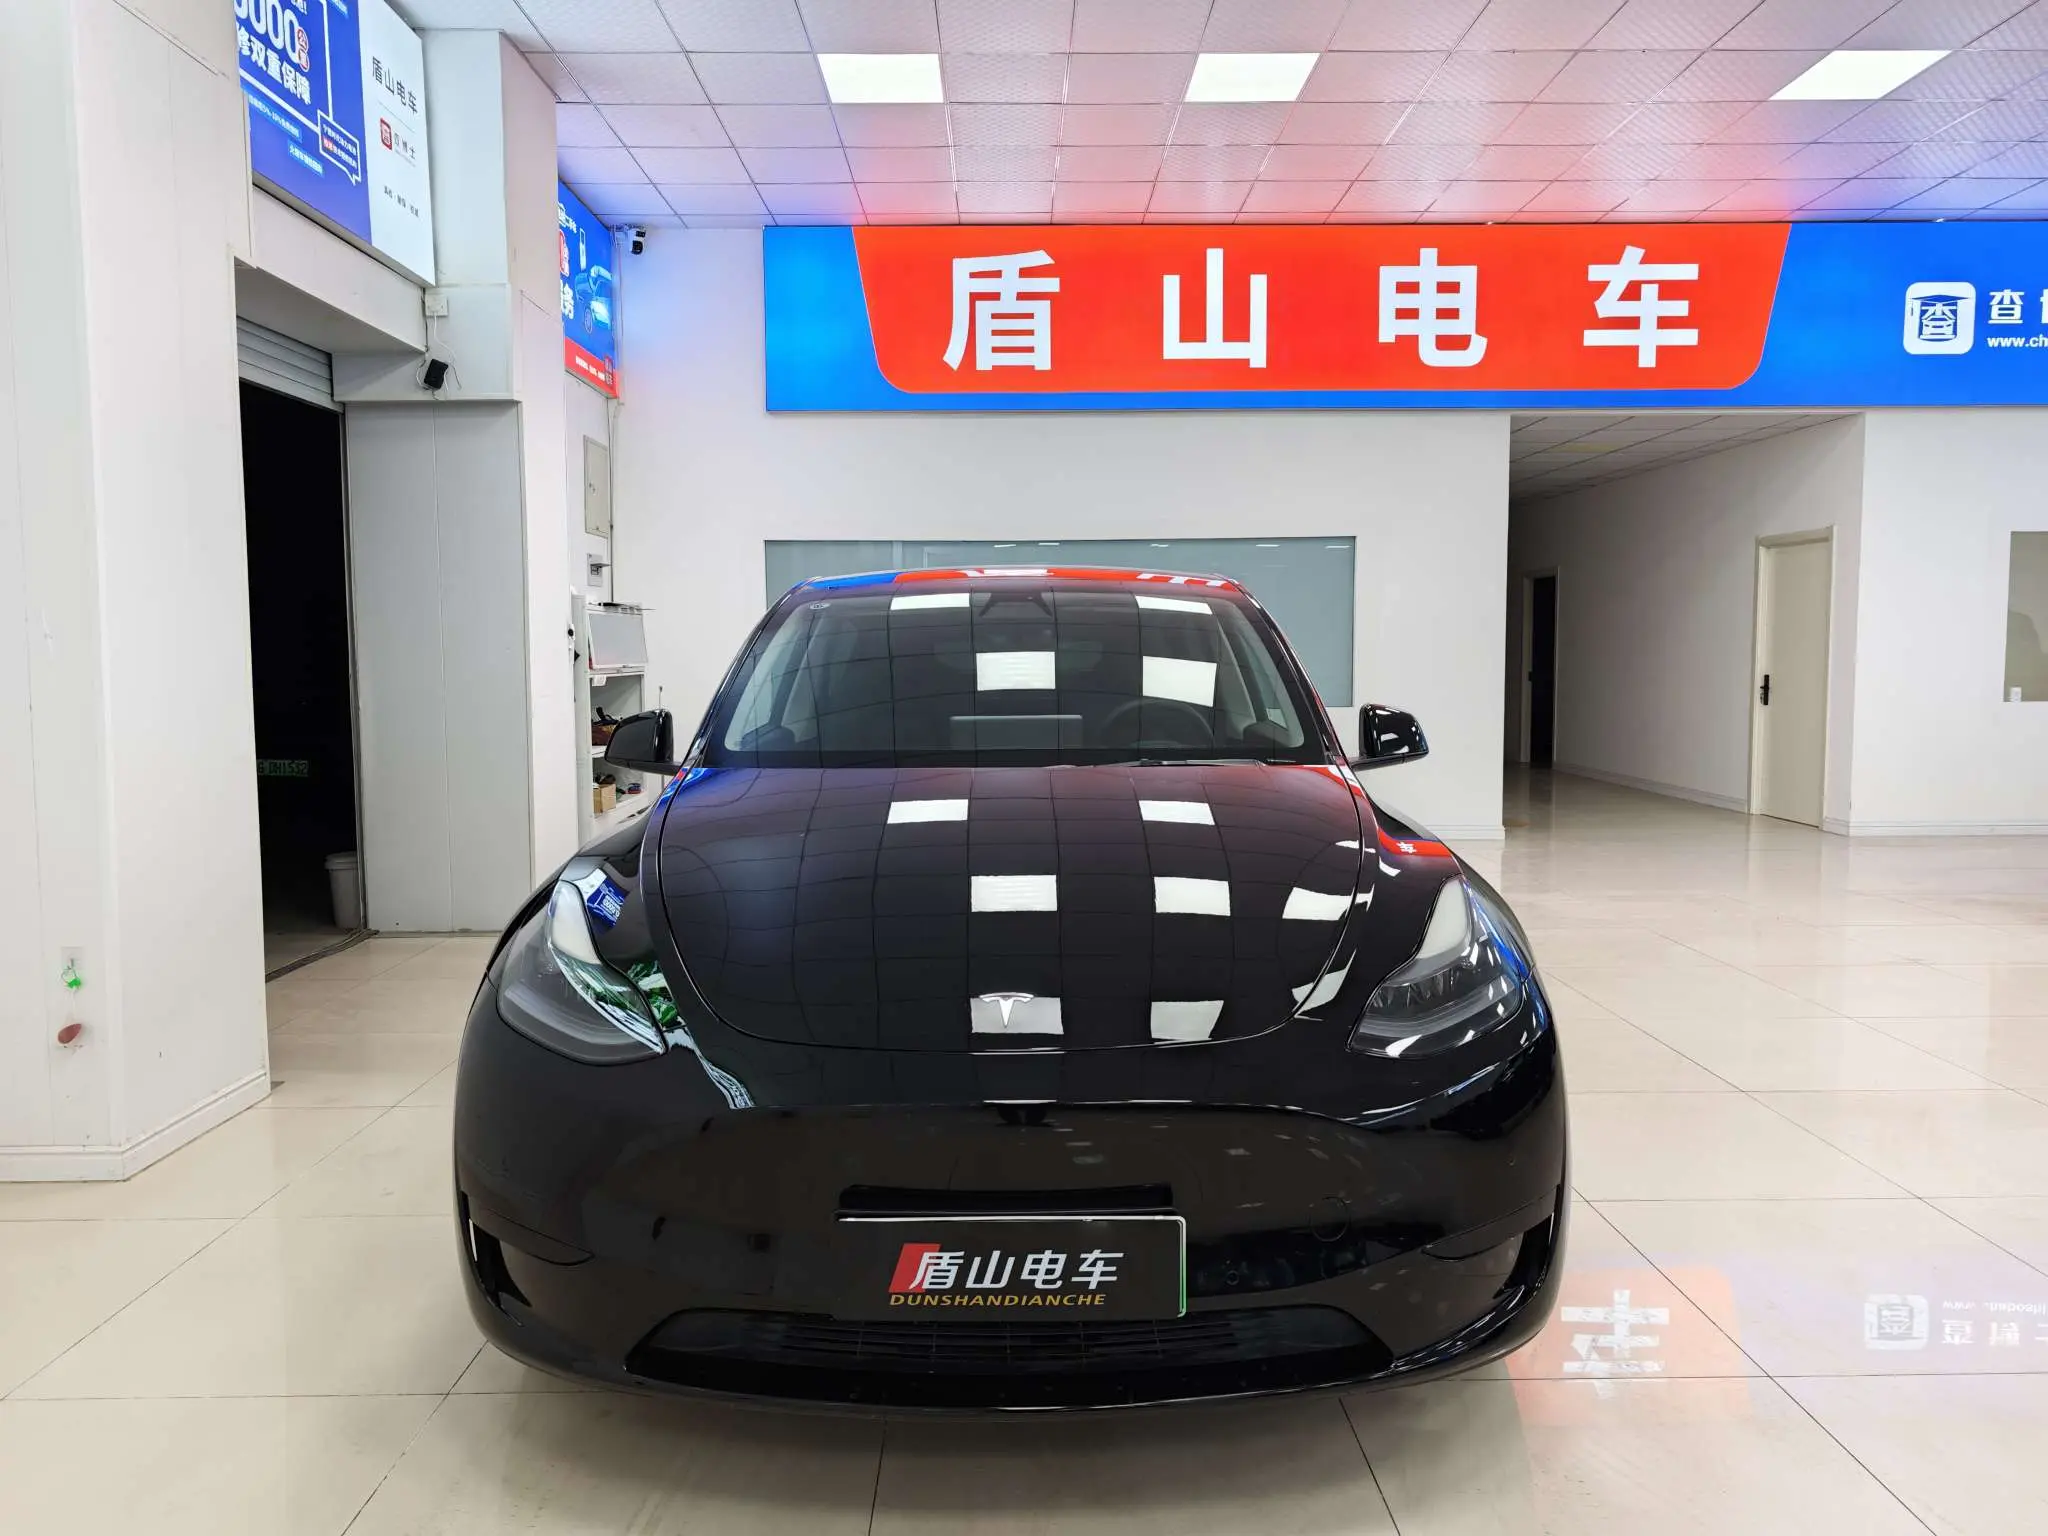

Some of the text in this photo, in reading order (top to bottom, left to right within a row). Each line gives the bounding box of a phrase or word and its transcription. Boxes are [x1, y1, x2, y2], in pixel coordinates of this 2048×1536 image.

[372, 56, 418, 115] 盾山电车
[943, 246, 1699, 371] 盾山电车
[1988, 289, 2048, 324] 查
[909, 1249, 1125, 1290] 盾山电车
[889, 1293, 1107, 1307] DUNSHANDIANCHE
